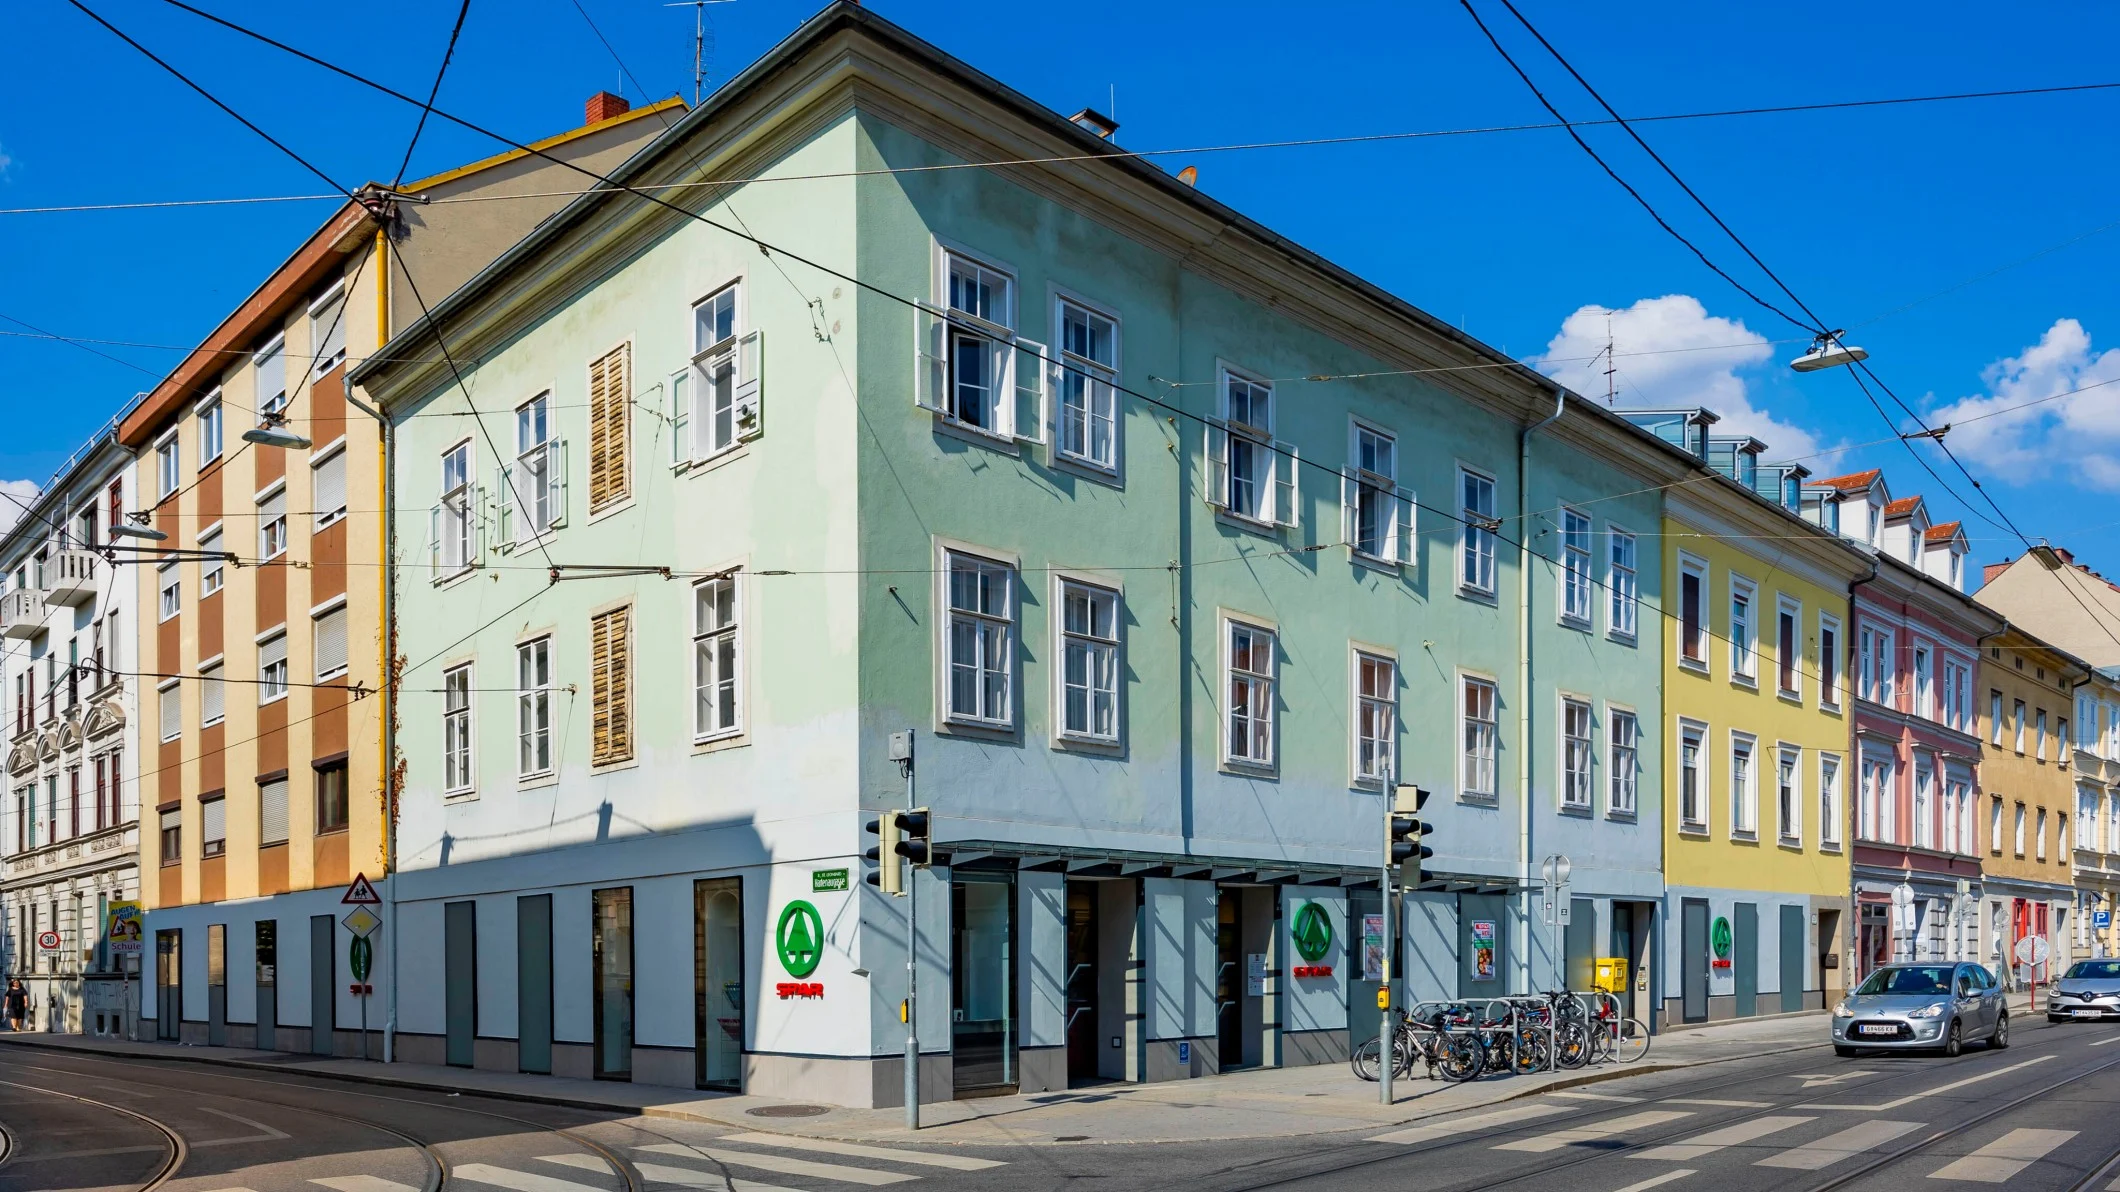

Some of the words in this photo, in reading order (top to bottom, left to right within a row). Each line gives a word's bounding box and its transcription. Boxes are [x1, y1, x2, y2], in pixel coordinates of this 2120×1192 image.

[111, 905, 135, 915] AUGEN
[2096, 912, 2106, 923] P
[44, 935, 55, 945] 30
[112, 942, 141, 950] Schule
[1293, 966, 1333, 977] SPAR
[776, 983, 824, 996] SPAR
